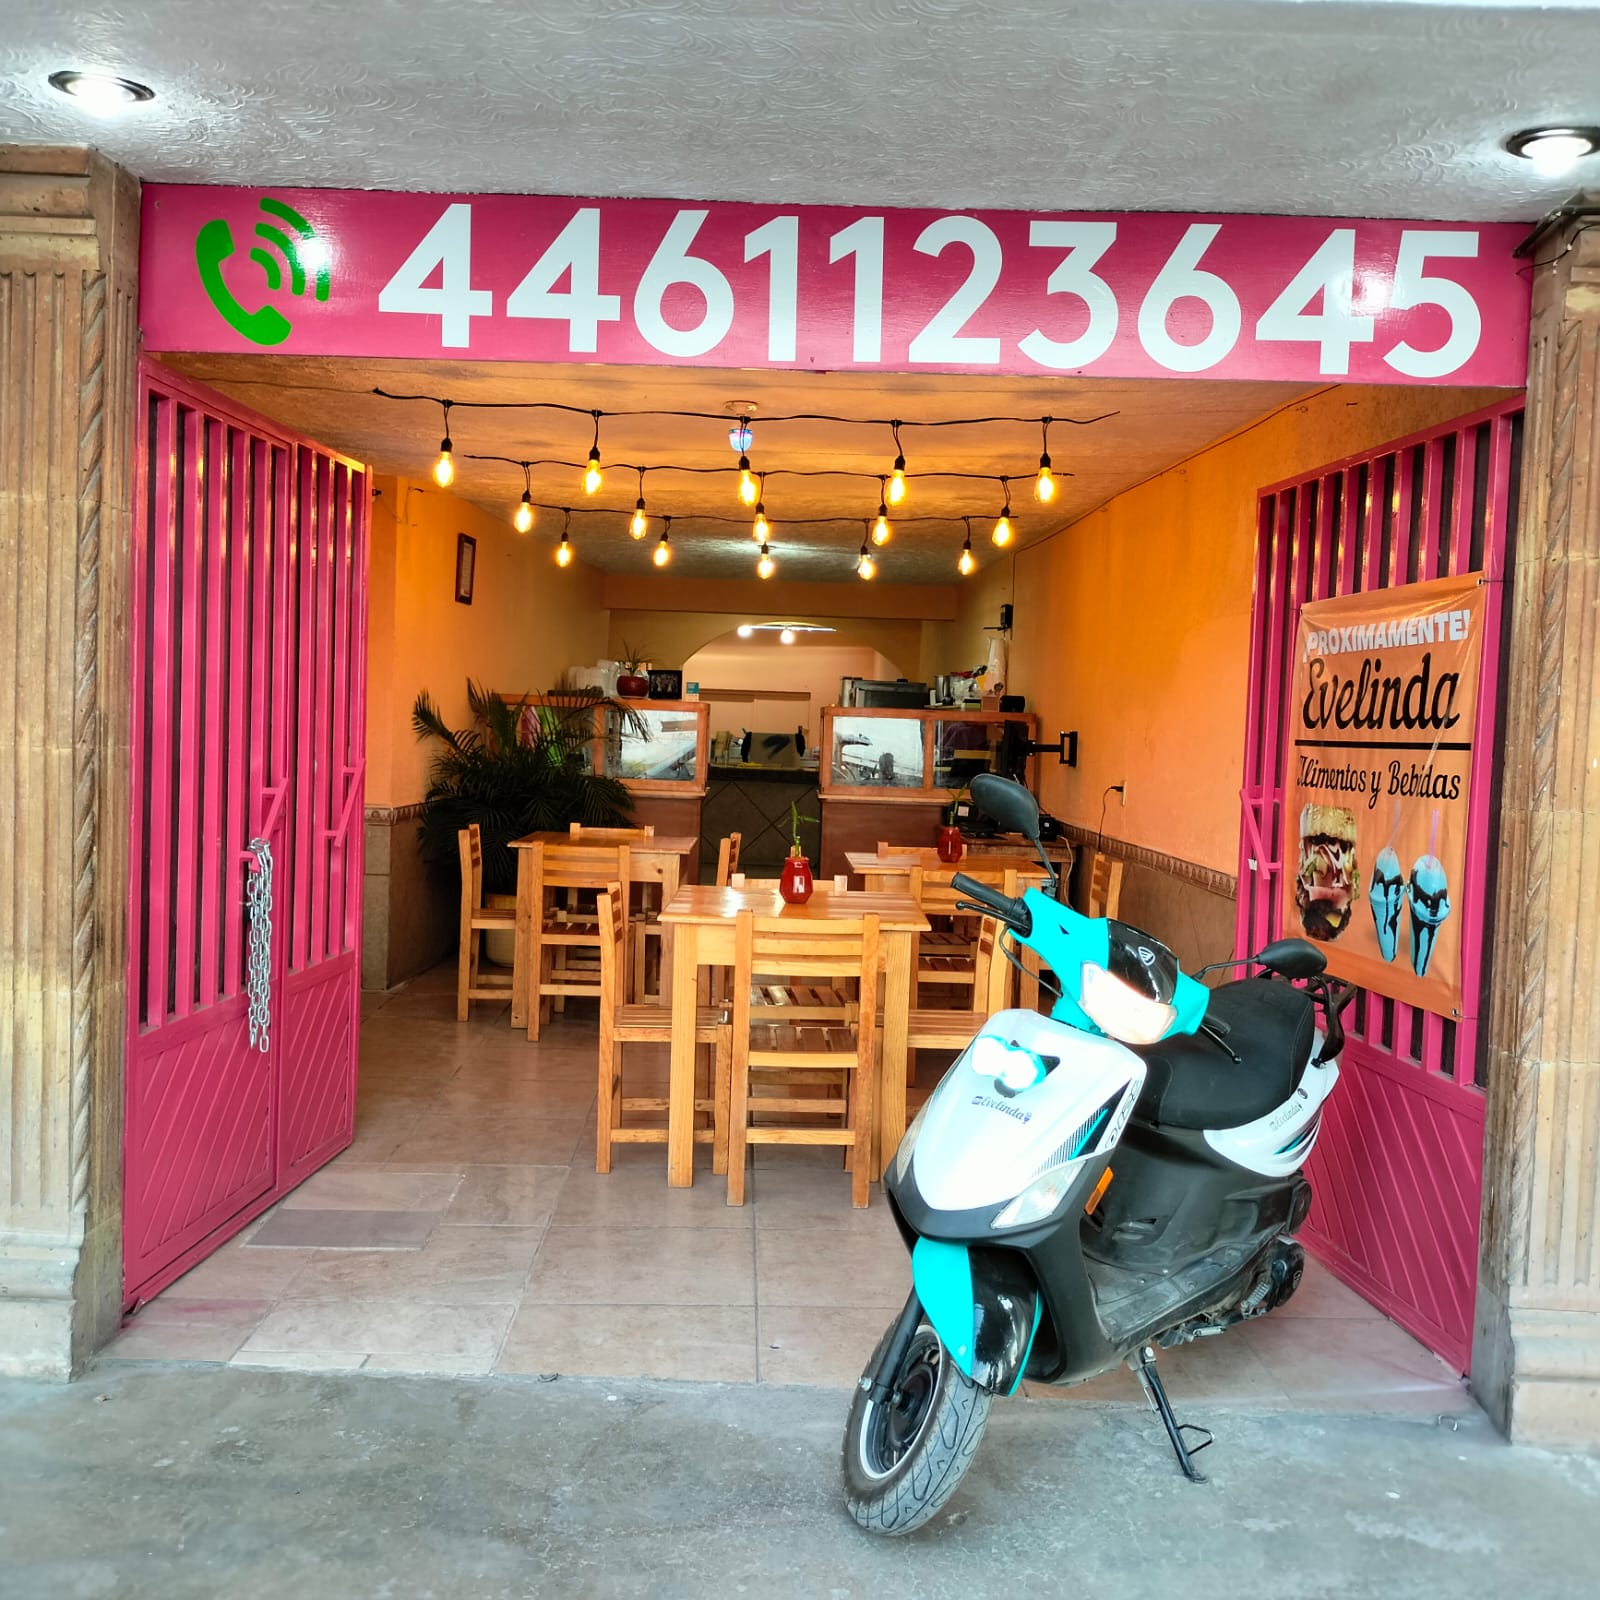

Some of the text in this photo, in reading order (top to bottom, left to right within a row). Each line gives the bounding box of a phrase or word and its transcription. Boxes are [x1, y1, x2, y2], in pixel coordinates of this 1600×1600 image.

[378, 202, 1481, 379] 4461123645
[1302, 652, 1461, 730] Evelinda
[1368, 770, 1382, 809] y
[1387, 759, 1461, 800] Bebidas
